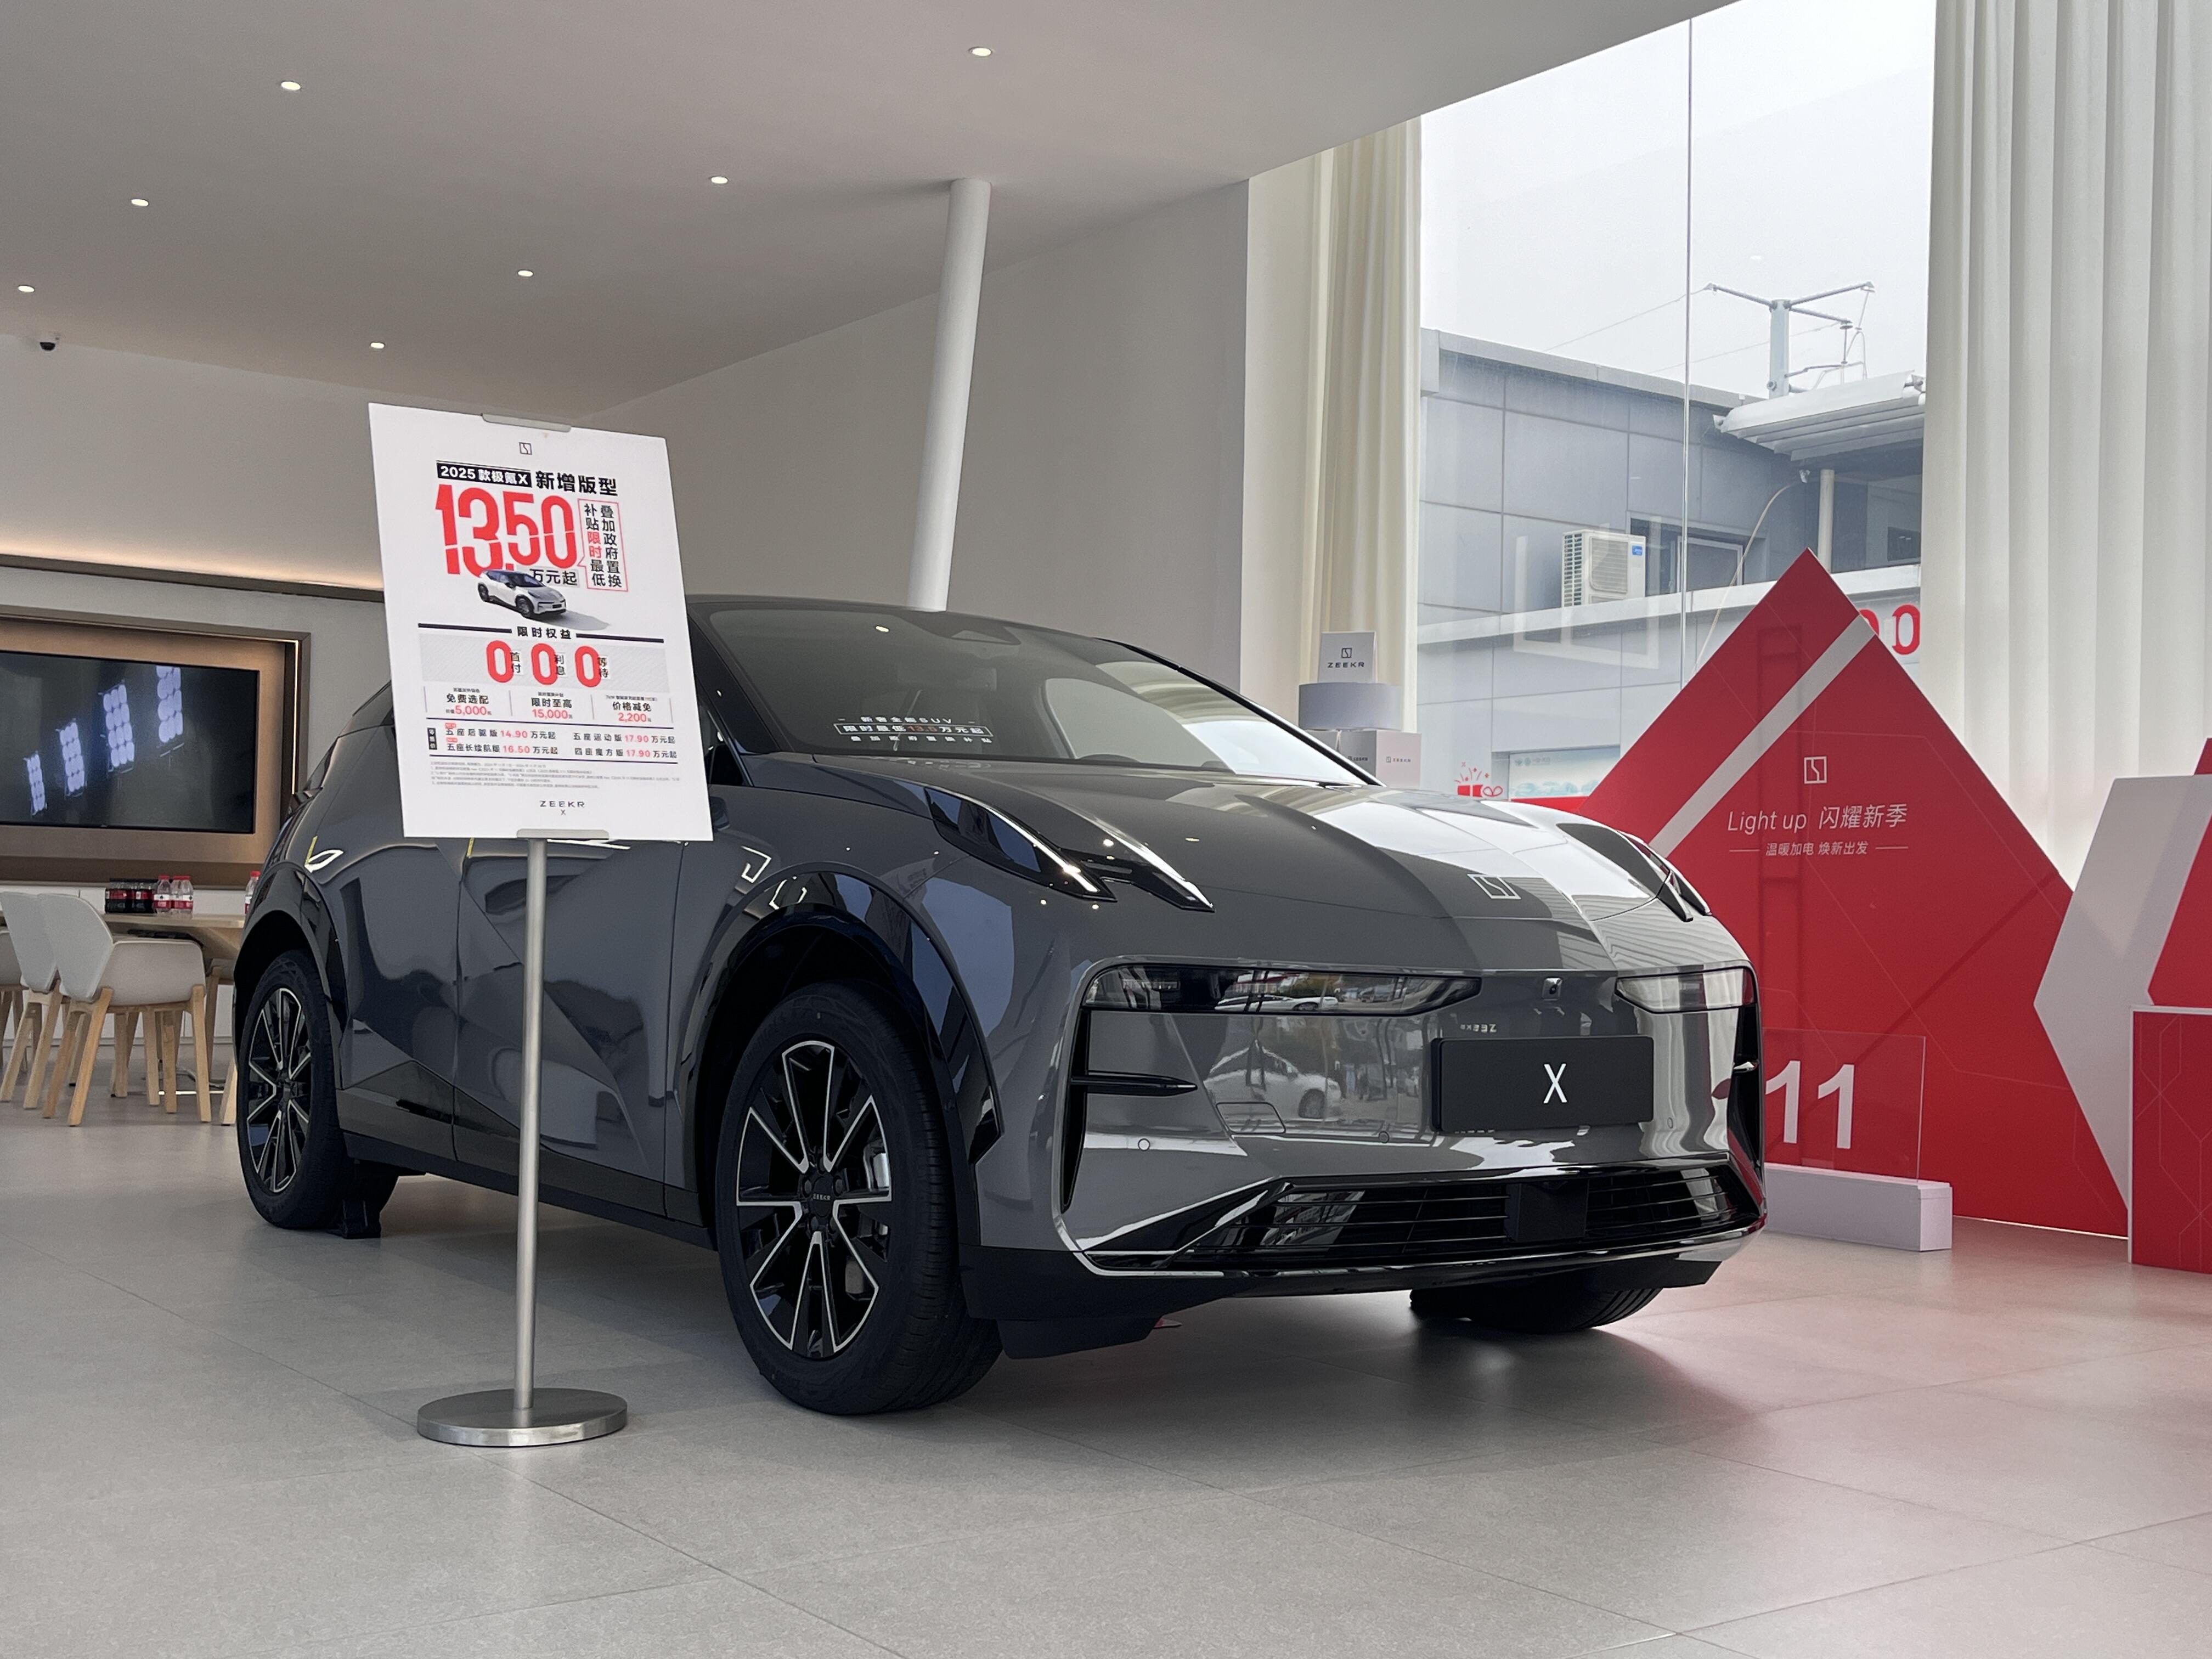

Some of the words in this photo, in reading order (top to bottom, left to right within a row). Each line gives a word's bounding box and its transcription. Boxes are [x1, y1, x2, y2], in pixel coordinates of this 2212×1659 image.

[535, 471, 618, 495] 新增版型
[435, 484, 577, 577] 13.50
[584, 503, 606, 586] 补贴限时最低
[600, 505, 622, 588] 叠加政府置换
[529, 568, 578, 585] 万元起
[517, 626, 571, 639] 限时权益
[486, 640, 514, 683] 0
[531, 643, 558, 686] 0
[575, 646, 601, 687] 0
[447, 693, 489, 704] 免费选配
[531, 697, 572, 708] 限时至高
[612, 702, 652, 712] 价格减免
[531, 731, 556, 740] 万元起
[651, 735, 676, 744] 万元起
[532, 746, 558, 755] 万元起
[653, 750, 678, 759] 万元起
[539, 800, 585, 808] ZEEKR
[1728, 811, 1778, 835] Light
[1782, 813, 1808, 833] up
[1819, 803, 1908, 831] 闪耀新季
[1765, 842, 1814, 856] 温暖加电
[1818, 841, 1869, 856] 焕新出发
[1543, 1063, 1568, 1104] X
[1765, 1060, 1855, 1149] 11
